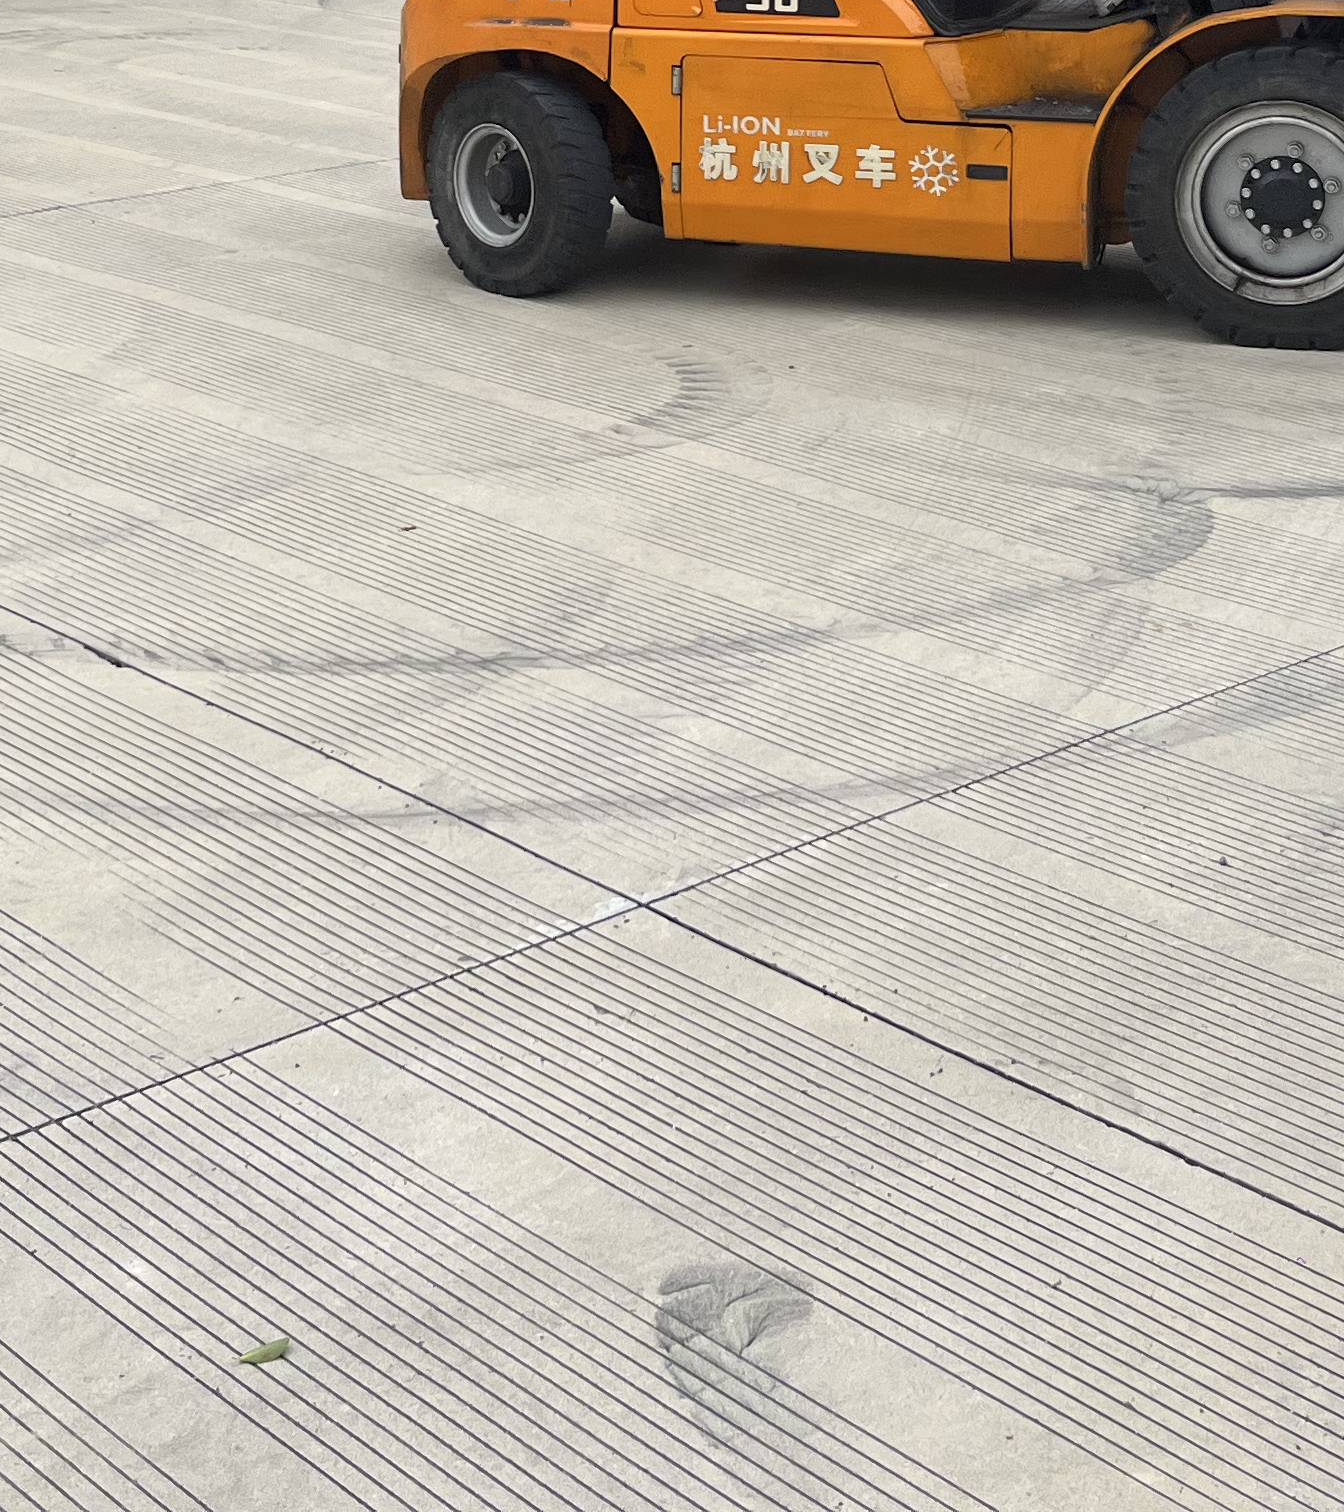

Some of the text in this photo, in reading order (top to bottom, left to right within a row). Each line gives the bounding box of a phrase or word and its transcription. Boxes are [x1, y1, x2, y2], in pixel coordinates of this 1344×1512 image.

[702, 114, 781, 136] Li-ION
[698, 136, 897, 188] 杭州叉车
